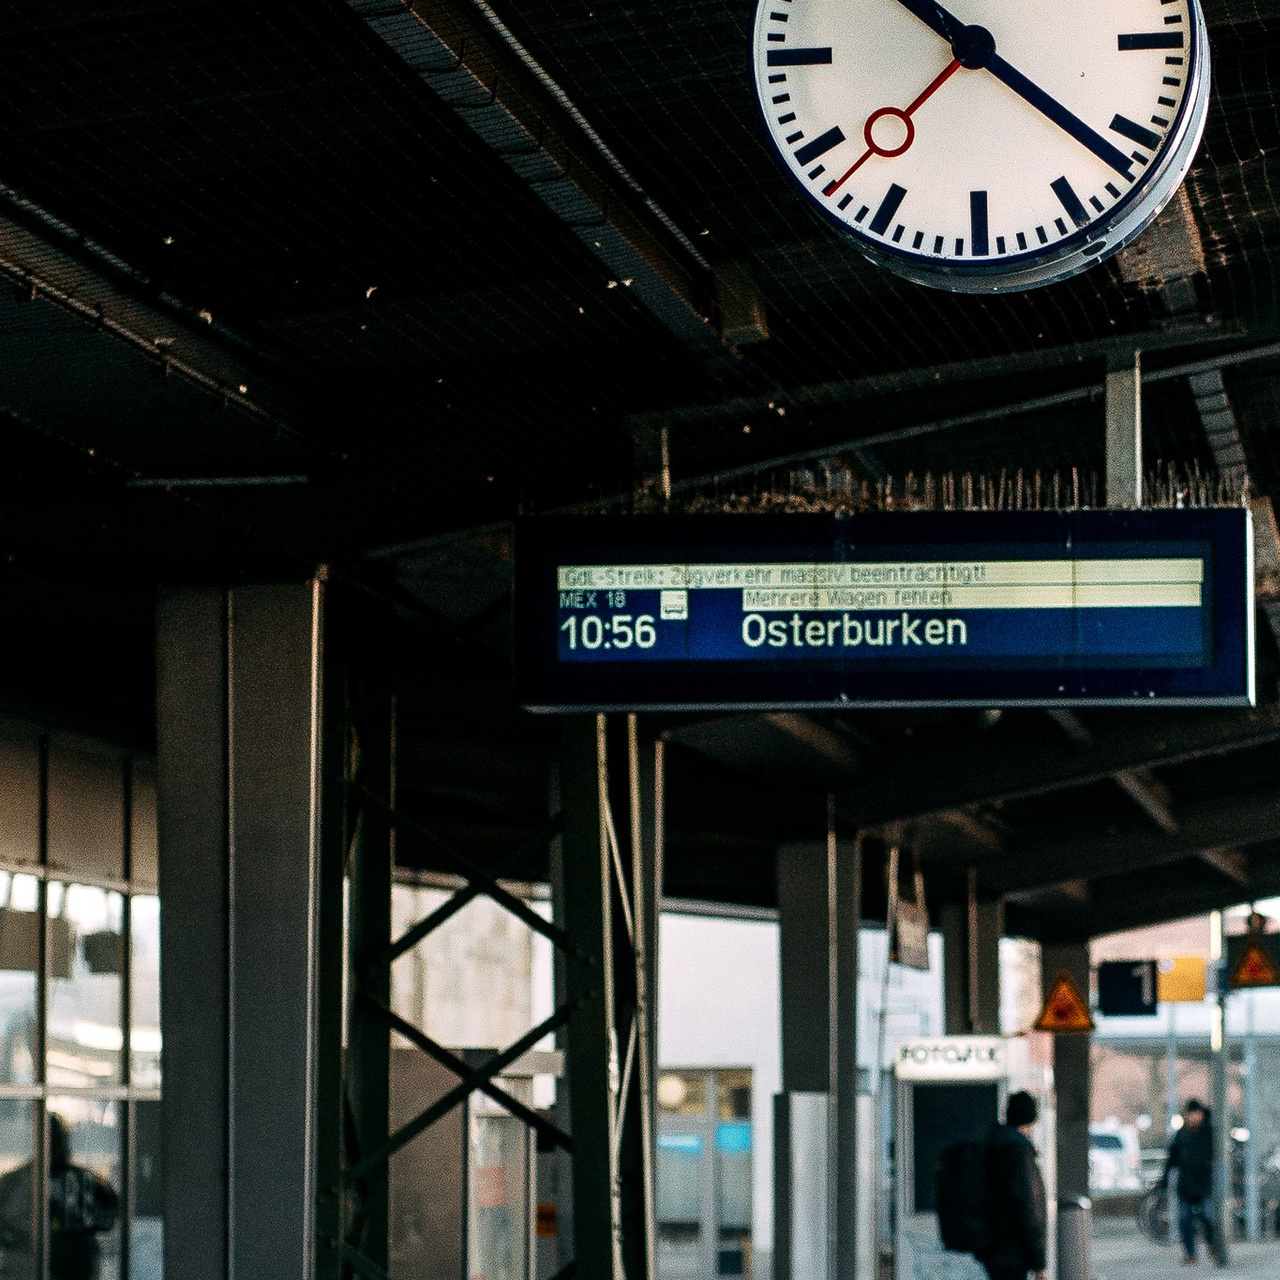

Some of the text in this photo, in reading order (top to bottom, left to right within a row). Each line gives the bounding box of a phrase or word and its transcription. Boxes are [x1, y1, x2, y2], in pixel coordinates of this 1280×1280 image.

[564, 566, 664, 587] GdL-Streik:
[670, 566, 772, 588] Zugverkehr
[780, 566, 845, 584] massiv
[559, 590, 627, 609] MEX 18
[745, 587, 954, 609] Mehrere Wagen fehlen
[560, 614, 657, 650] 10:56
[741, 612, 968, 648] Osterburken
